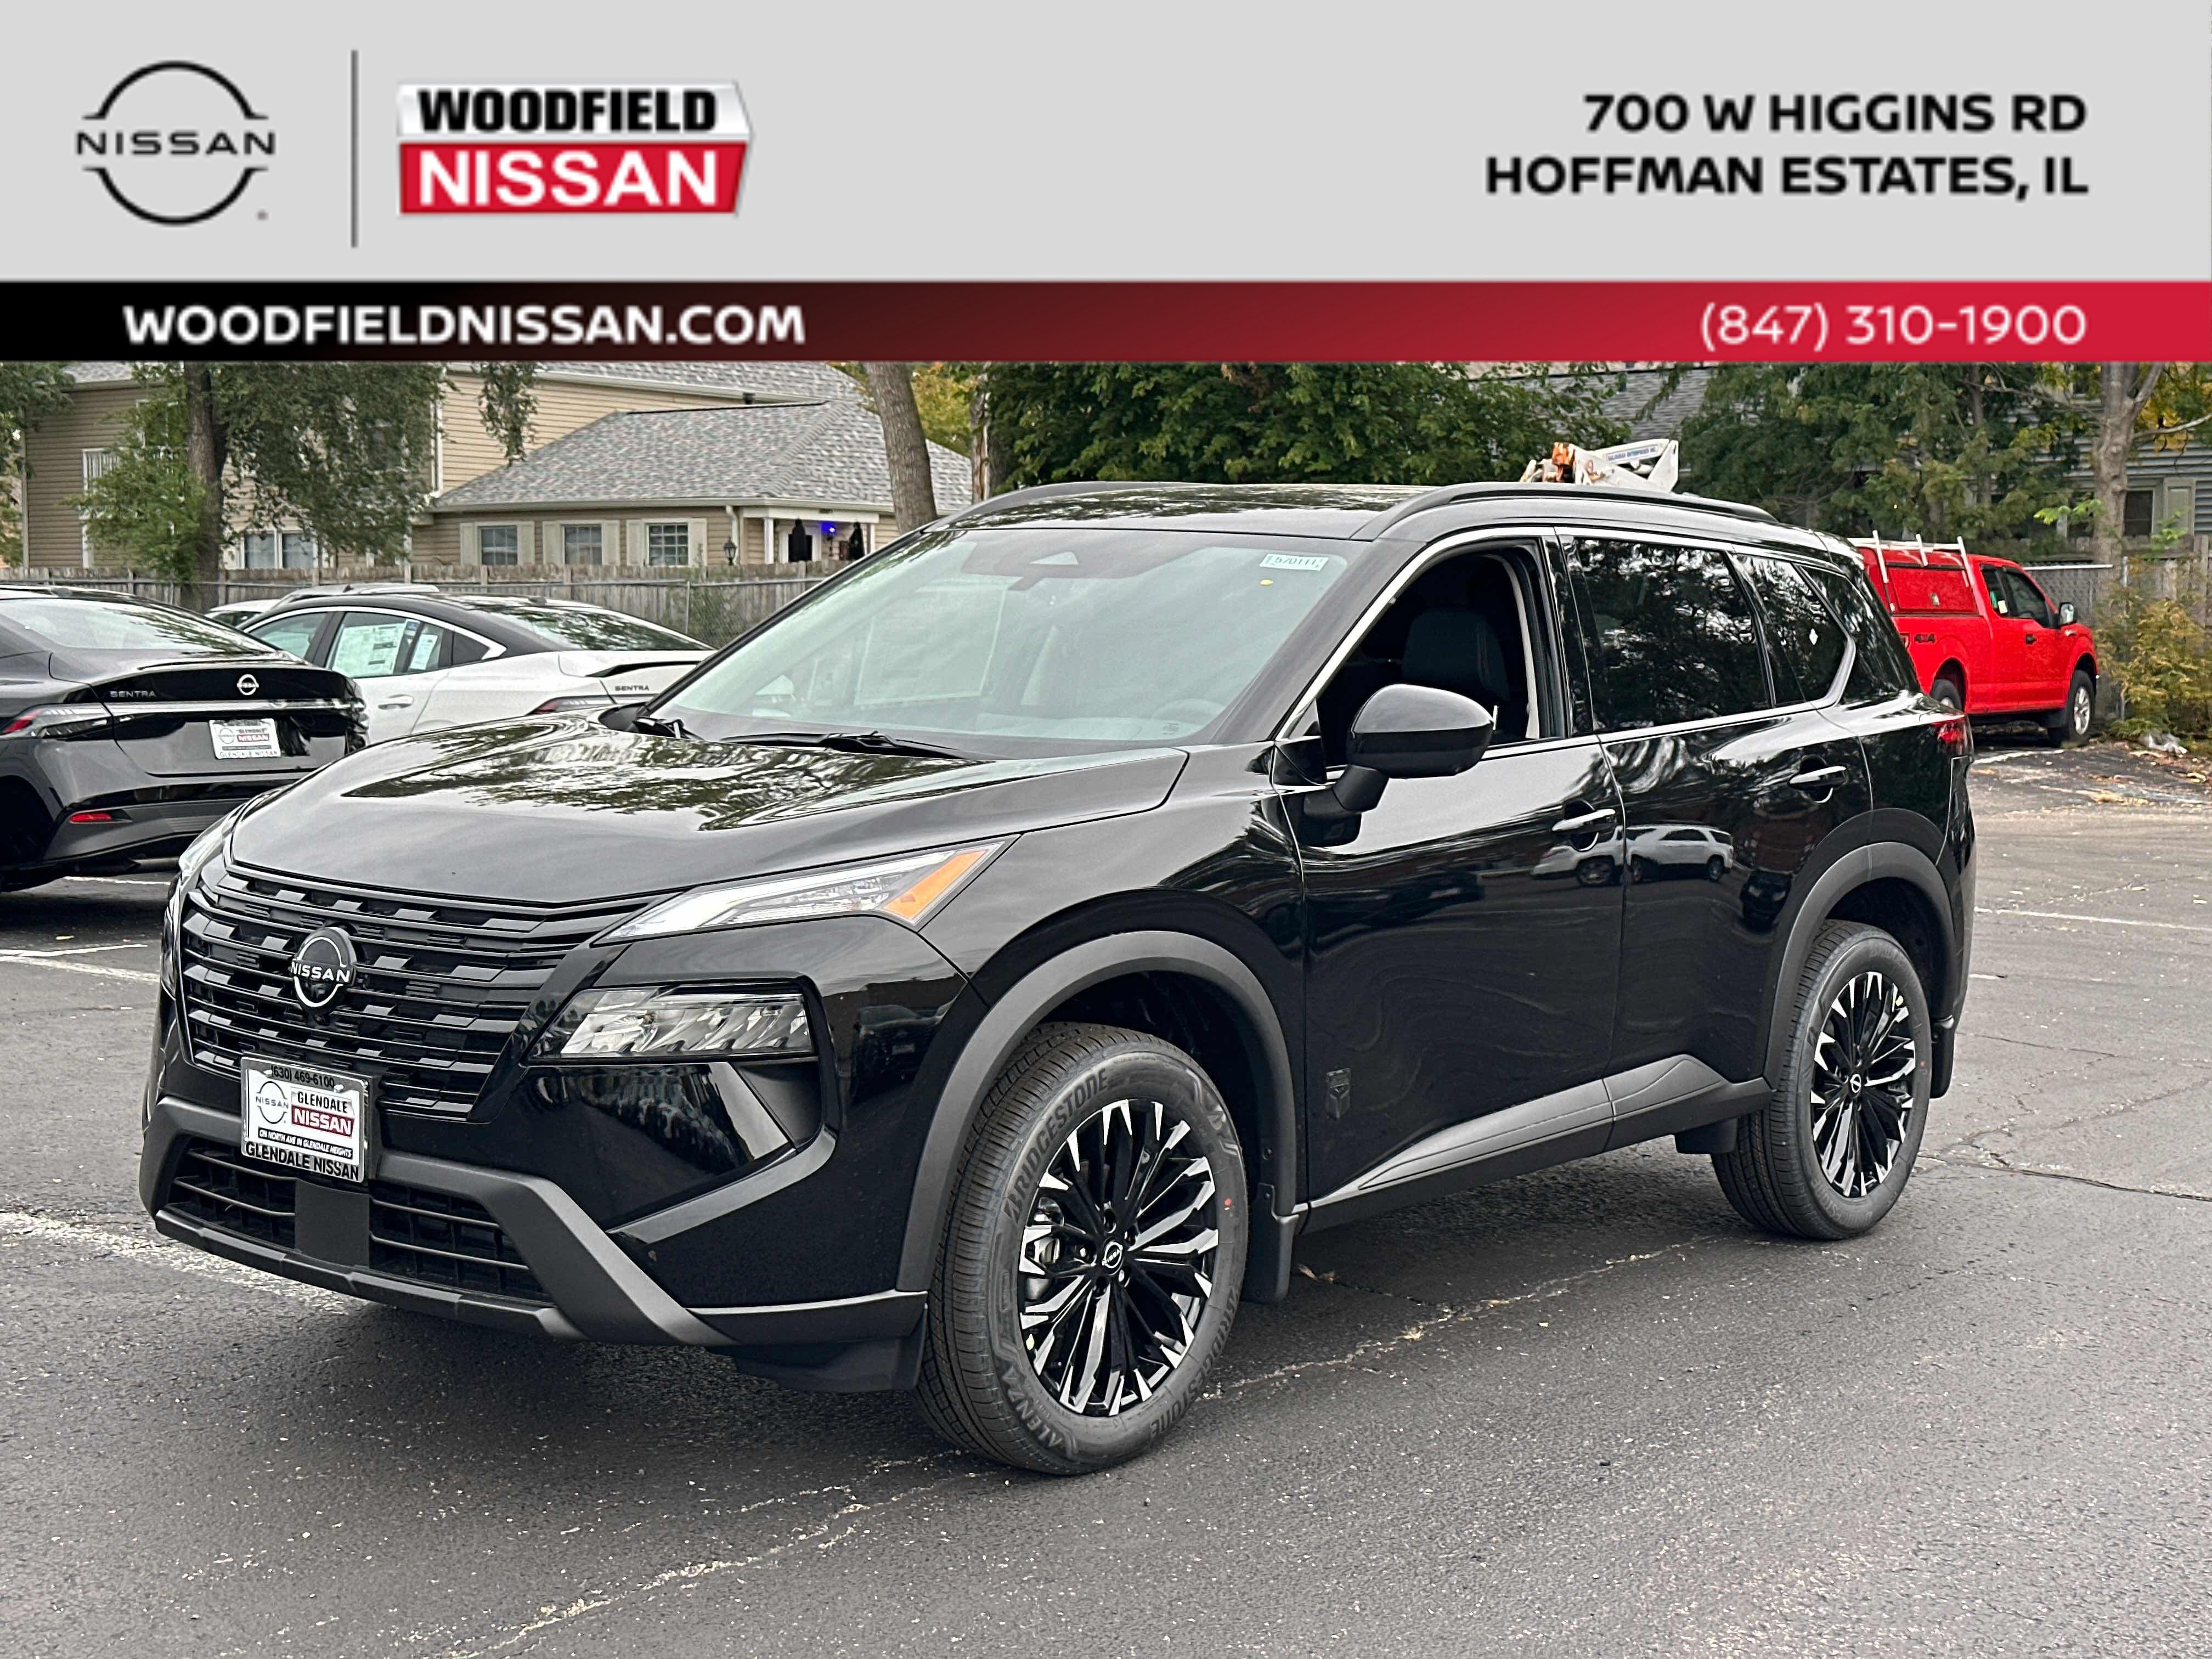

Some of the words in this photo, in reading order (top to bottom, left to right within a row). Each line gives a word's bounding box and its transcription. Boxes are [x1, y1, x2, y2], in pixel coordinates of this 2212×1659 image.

[290, 961, 351, 983] NISSAN
[295, 1071, 335, 1088] 469-6100
[256, 1096, 289, 1109] NISSAN
[297, 1091, 348, 1113] GLENDALE
[294, 1108, 351, 1135] NISSAN
[268, 1132, 286, 1142] NORTH
[302, 1139, 330, 1153] GLENDALE
[330, 1144, 352, 1158] HEIGHTS
[1003, 1067, 1113, 1224] BRIDGESTONE
[246, 1141, 311, 1169] GLENDALE
[313, 1156, 360, 1181] NISSAN
[1002, 1365, 1063, 1448] ALENZA
